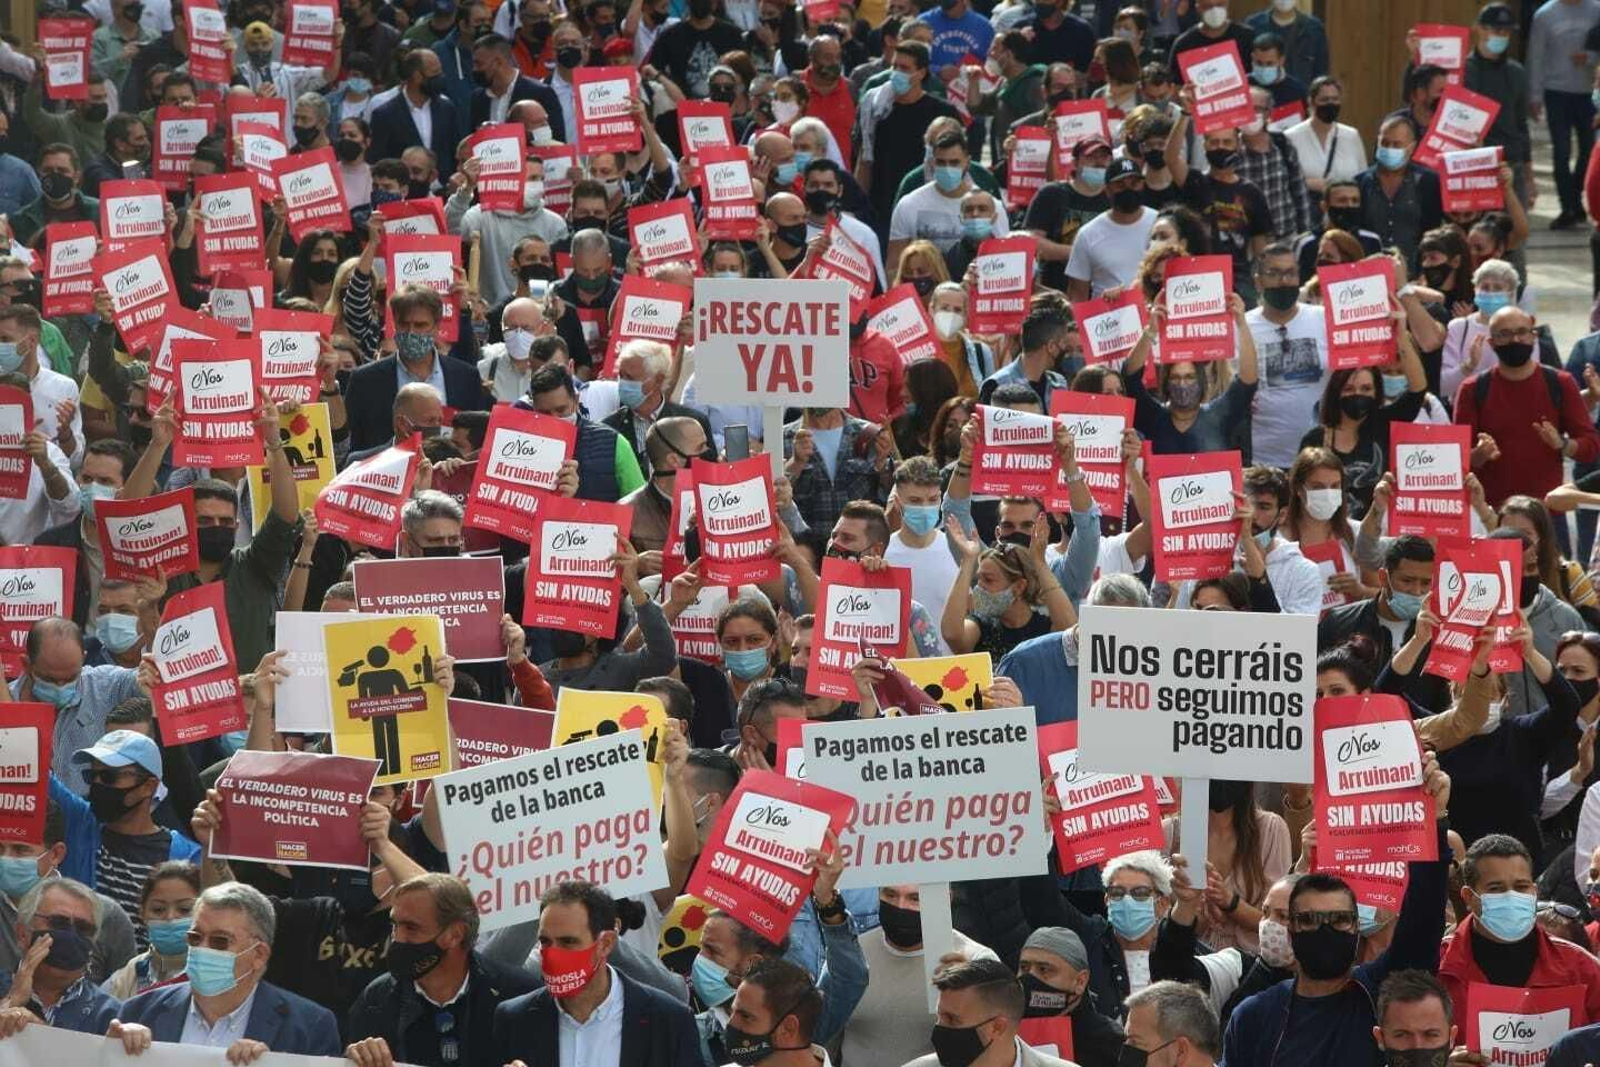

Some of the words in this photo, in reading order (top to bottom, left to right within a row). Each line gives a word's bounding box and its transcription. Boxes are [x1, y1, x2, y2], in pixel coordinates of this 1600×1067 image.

[588, 88, 610, 101] Nos
[584, 124, 598, 136] SIN
[601, 122, 634, 134] AYUDAS
[290, 176, 312, 192] Nos
[486, 181, 519, 191] AYUDAS
[1464, 175, 1497, 189] AYUDAS
[116, 204, 141, 218] Nos
[208, 197, 231, 212] Nos
[708, 207, 722, 218] SIN
[725, 206, 756, 218] AYUDAS
[116, 219, 162, 234] Arruinan!
[210, 213, 252, 228] Arruinan!
[57, 245, 79, 259] Nos
[204, 239, 220, 251] SIN
[222, 237, 258, 250] AYUDAS
[646, 240, 688, 259] Arruinan!
[404, 259, 429, 275] Nos
[47, 284, 58, 295] SIN
[60, 282, 92, 293] AYUDAS
[116, 271, 139, 292] Nos
[983, 275, 1021, 290] Arruinan!
[1174, 282, 1202, 297] Nos
[119, 281, 164, 306] Arruinan!
[1339, 286, 1364, 304] Nos
[631, 306, 658, 318] Nos
[976, 299, 990, 311] SIN
[992, 299, 1024, 312] AYUDAS
[1173, 297, 1221, 315] Arruinan!
[1340, 302, 1387, 321] Arruinan!
[627, 320, 674, 339] Arruinan!
[700, 301, 840, 342] ¡RESCATE
[1166, 324, 1183, 337] SIN
[1186, 322, 1227, 337] AYUDAS
[1333, 330, 1350, 345] SIN
[1352, 326, 1392, 344] AYUDAS
[269, 337, 298, 356] Nos
[265, 361, 313, 374] Arruinan!
[738, 344, 813, 393] YA!
[192, 369, 224, 389] Nos
[192, 391, 248, 409] Arruinan!
[182, 422, 201, 436] SIN
[206, 421, 254, 438] AYUDAS
[992, 424, 1048, 441] Arruinan!
[502, 440, 537, 456] Nos
[982, 453, 1002, 468] SIN
[1005, 454, 1052, 470] AYUDAS
[1405, 450, 1434, 469] Nos
[494, 462, 554, 484] Arruinan!
[1404, 473, 1457, 488] Arruinan!
[478, 483, 498, 500] SIN
[1171, 483, 1204, 503] Nos
[326, 489, 348, 506] SIN
[350, 494, 396, 521] AYUDAS
[708, 494, 740, 511] Nos
[1396, 497, 1416, 512] SIN
[1418, 498, 1463, 514] AYUDAS
[708, 511, 765, 533] Arruinan!
[1172, 504, 1230, 524] Arruinan!
[119, 520, 154, 534] Nos
[120, 526, 183, 550] Arruinan!
[552, 530, 589, 549] Nos
[1162, 534, 1184, 551] SIN
[1188, 531, 1235, 550] AYUDAS
[139, 543, 188, 568] AYUDAS
[705, 540, 721, 558] SIN
[724, 538, 772, 559] AYUDAS
[2, 576, 35, 596] Nos
[536, 582, 558, 598] SIN
[561, 584, 612, 606] AYUDAS
[361, 598, 373, 607] EL
[377, 594, 447, 605] VERDADERO
[450, 592, 481, 602] VIRUS
[483, 591, 500, 600] ES
[837, 594, 871, 614] Nos
[0, 601, 57, 618] Arruinan!
[392, 604, 488, 615] INCOMPETENCIA
[833, 621, 894, 638] Arruinan!
[161, 625, 191, 654] Nos
[165, 646, 222, 677] Arruinan!
[819, 648, 839, 666] SIN
[1091, 634, 1160, 676] Nos
[1173, 643, 1303, 683] cerráis
[164, 690, 189, 710] SIN
[192, 678, 236, 705] AYUDAS
[1090, 680, 1150, 711] PERO
[1157, 683, 1303, 720] seguimos
[814, 734, 915, 761] Pagamos
[921, 728, 940, 749] el
[947, 723, 1027, 749] rescate
[1173, 718, 1303, 754] pagando
[456, 738, 508, 754] RDADERO
[1337, 732, 1380, 762] Nos
[444, 769, 540, 805] Pagamos
[544, 757, 561, 780] el
[564, 740, 640, 772] rescate
[861, 761, 887, 782] de
[893, 760, 913, 780] la
[919, 753, 985, 778] banca
[1339, 762, 1416, 790] Arruinan!
[221, 779, 234, 788] EL
[238, 780, 308, 797] VERDADERO
[310, 788, 345, 802] VIRUS
[348, 794, 363, 804] ES
[1069, 775, 1136, 805] Arruinan!
[232, 793, 247, 804] LA
[250, 796, 349, 817] INCOMPETENCIA
[491, 800, 515, 823] de
[519, 794, 536, 818] la
[544, 780, 605, 810] banca
[945, 788, 1030, 826] paga
[264, 811, 319, 827] POLÍTICA
[747, 805, 791, 827] Nos
[1063, 815, 1087, 837] SIN
[1091, 802, 1149, 830] AYUDAS
[1328, 805, 1355, 827] SIN
[1360, 801, 1425, 825] AYUDAS
[458, 826, 563, 881] ¿Quién
[575, 808, 650, 848] paga
[736, 829, 809, 864] Arruinan!
[841, 834, 864, 867] el
[875, 825, 1024, 865] nuestro?
[711, 851, 740, 876] SIN
[741, 864, 800, 906] AYUDAS
[479, 878, 502, 915] el
[1492, 1020, 1536, 1040] Nos
[1492, 1046, 1551, 1067] Arruina
